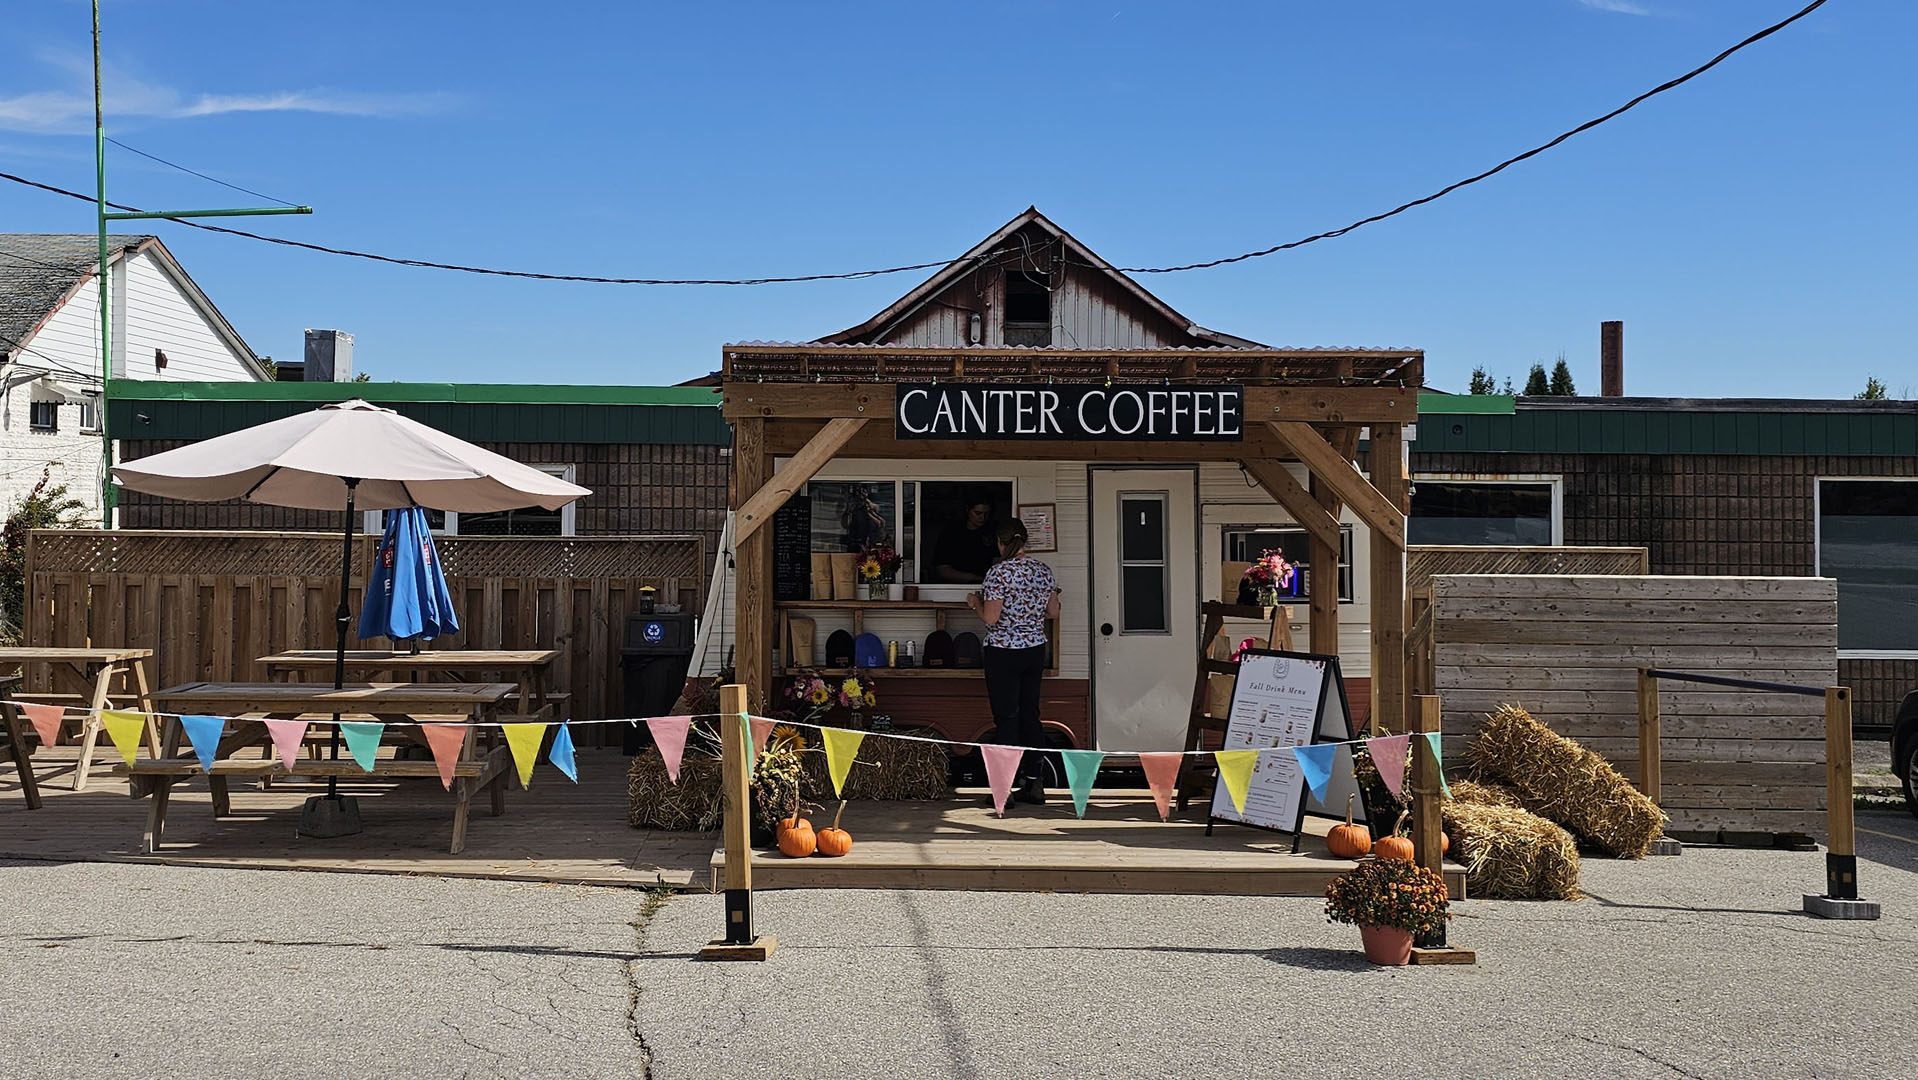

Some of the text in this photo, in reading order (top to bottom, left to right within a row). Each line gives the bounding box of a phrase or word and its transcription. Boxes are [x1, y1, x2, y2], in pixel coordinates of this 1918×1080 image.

[899, 389, 1240, 435] CANTER COFFEE
[1249, 682, 1306, 695] Fall Drink Menu
